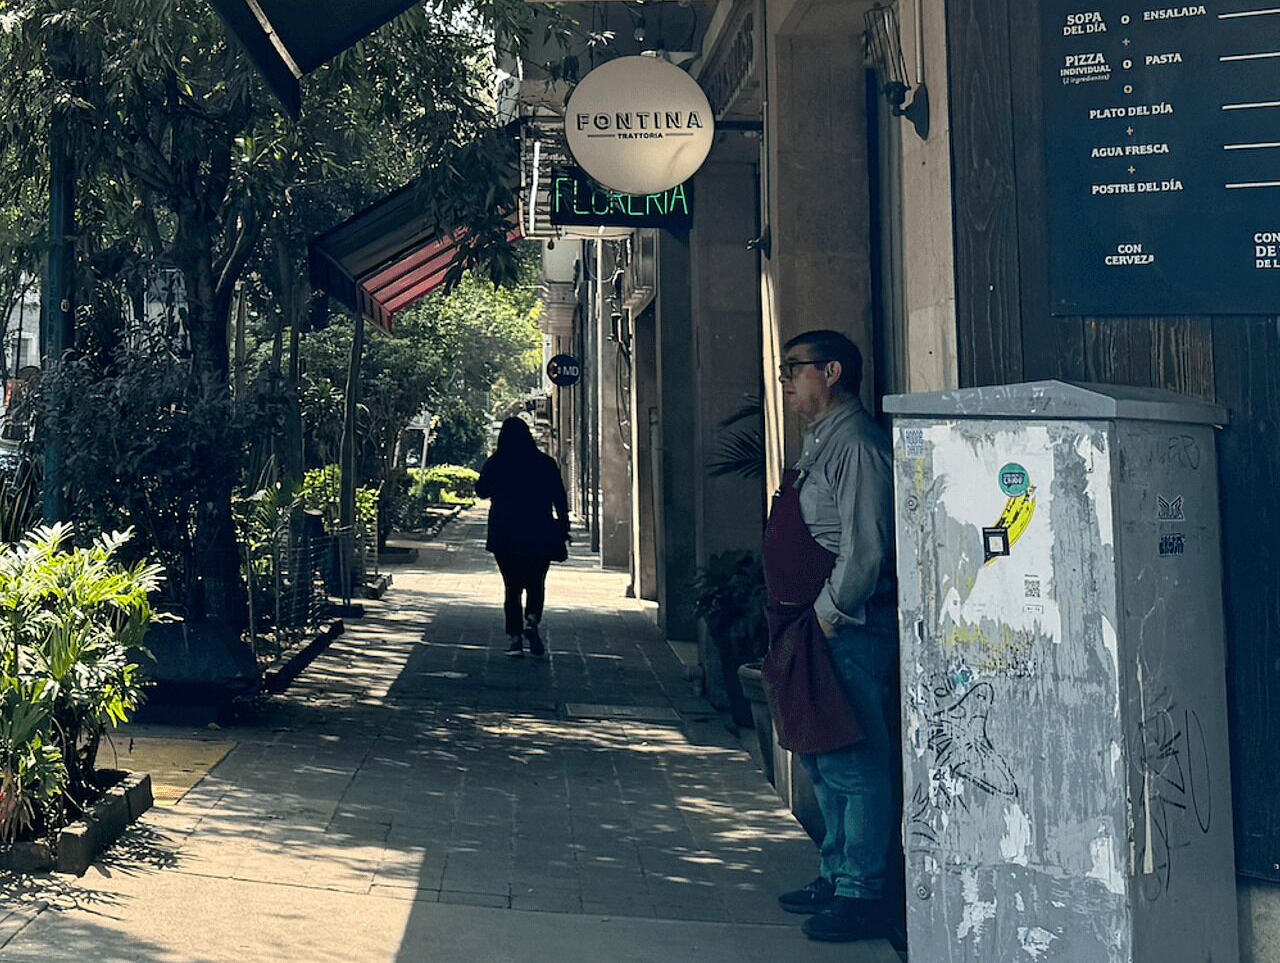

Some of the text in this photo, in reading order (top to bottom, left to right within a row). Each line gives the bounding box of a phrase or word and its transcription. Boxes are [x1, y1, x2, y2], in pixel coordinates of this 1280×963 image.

[1067, 12, 1102, 25] SOPA
[1143, 6, 1206, 21] ENSALADA
[1063, 21, 1107, 35] DEL DÍA
[1065, 53, 1105, 66] PIZZA
[1145, 53, 1182, 65] PASTA
[1060, 65, 1111, 76] INDIVIDUAL
[1089, 102, 1173, 119] PLATO DEL DÍA
[577, 111, 703, 131] FONTINA
[1091, 144, 1169, 157] AGUA FRESCA
[1092, 178, 1183, 194] POSTRE DEL DÍA
[1117, 244, 1142, 253] CON
[1256, 246, 1277, 257] DE
[1104, 254, 1154, 266] CERVEZA
[1256, 259, 1271, 268] DE
